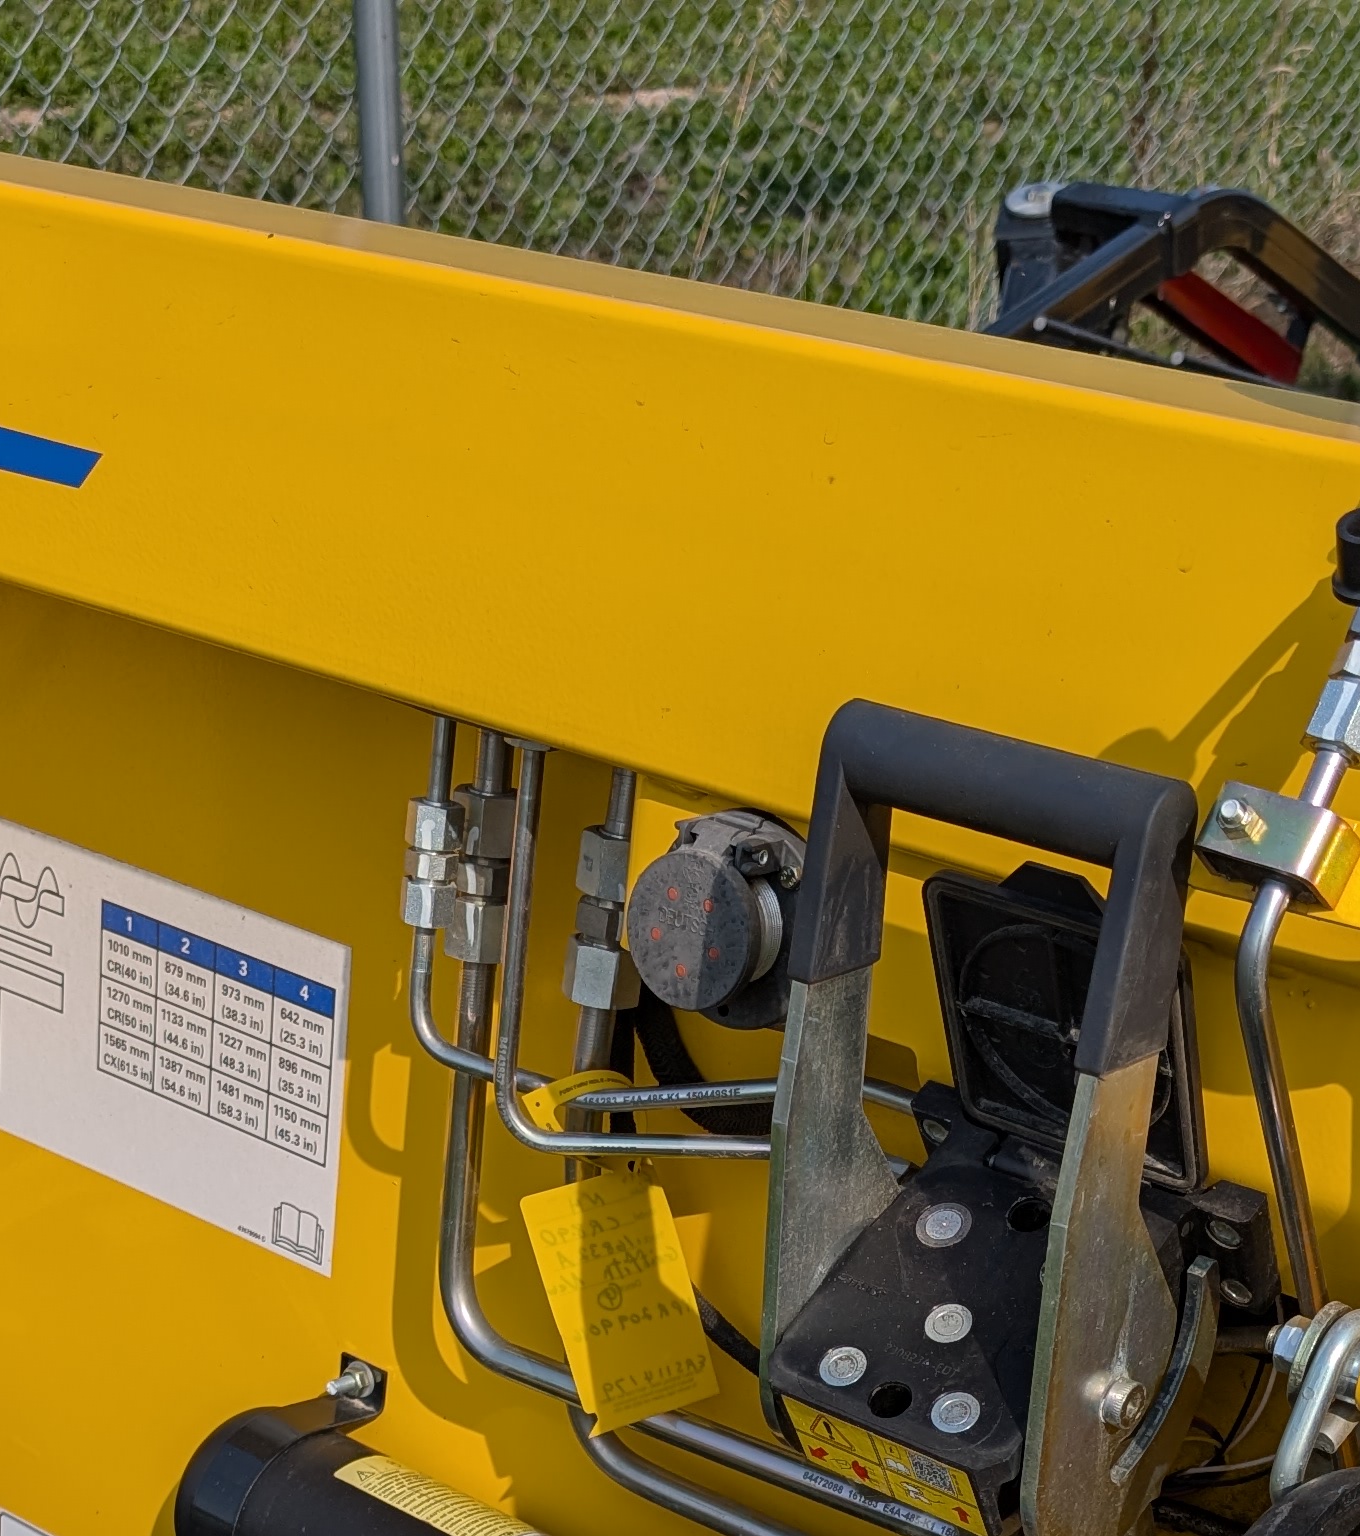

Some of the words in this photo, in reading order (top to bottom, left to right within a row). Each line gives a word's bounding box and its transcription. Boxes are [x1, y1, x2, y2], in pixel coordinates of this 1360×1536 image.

[124, 916, 134, 932] 1
[107, 938, 131, 959] 1010
[132, 950, 153, 966] mm
[180, 937, 191, 955] 2
[139, 972, 153, 989] in)
[164, 960, 184, 978] 879
[185, 972, 207, 988] mm
[238, 960, 249, 977] 3
[106, 985, 131, 1006] 1270
[132, 997, 154, 1015] mm
[164, 981, 191, 1003] (34.6
[192, 993, 207, 1010] in)
[221, 983, 242, 1001] 973
[243, 995, 266, 1012] mm
[298, 985, 310, 1001] 4
[139, 1019, 154, 1038] in)
[160, 1008, 185, 1028] 1133
[186, 1020, 208, 1037] mm
[221, 1004, 248, 1027] (38.3
[249, 1016, 265, 1034] in)
[280, 1007, 301, 1025] 642
[302, 1019, 326, 1036] mm
[103, 1033, 128, 1053] 1565
[129, 1045, 151, 1062] mm
[163, 1029, 189, 1052] (44.6
[190, 1041, 206, 1060] in)
[218, 1031, 244, 1051] 1227
[245, 1044, 268, 1062] mm
[280, 1027, 307, 1050] (25.3
[308, 1040, 324, 1058] in)
[140, 1067, 155, 1085] in)
[159, 1055, 184, 1076] 1387
[185, 1068, 207, 1085] mm
[218, 1052, 246, 1076] (48.3
[246, 1065, 262, 1083] in)
[277, 1057, 299, 1075] 896
[300, 1068, 323, 1085] mm
[160, 1076, 187, 1099] (54.6
[187, 1088, 203, 1106] in)
[216, 1080, 241, 1100] 1481
[243, 1093, 265, 1110] mm
[277, 1077, 305, 1100] (35.3
[306, 1090, 322, 1108] in)
[685, 1087, 741, 1101] 150449S1E
[216, 1101, 243, 1124] (58.3
[244, 1113, 260, 1131] in)
[273, 1104, 298, 1124] 1150
[300, 1117, 322, 1135] mm
[274, 1124, 302, 1148] (45.3
[302, 1137, 319, 1156] in)
[802, 1471, 845, 1495] 84472088
[882, 1503, 937, 1532] E4A-485-K1
